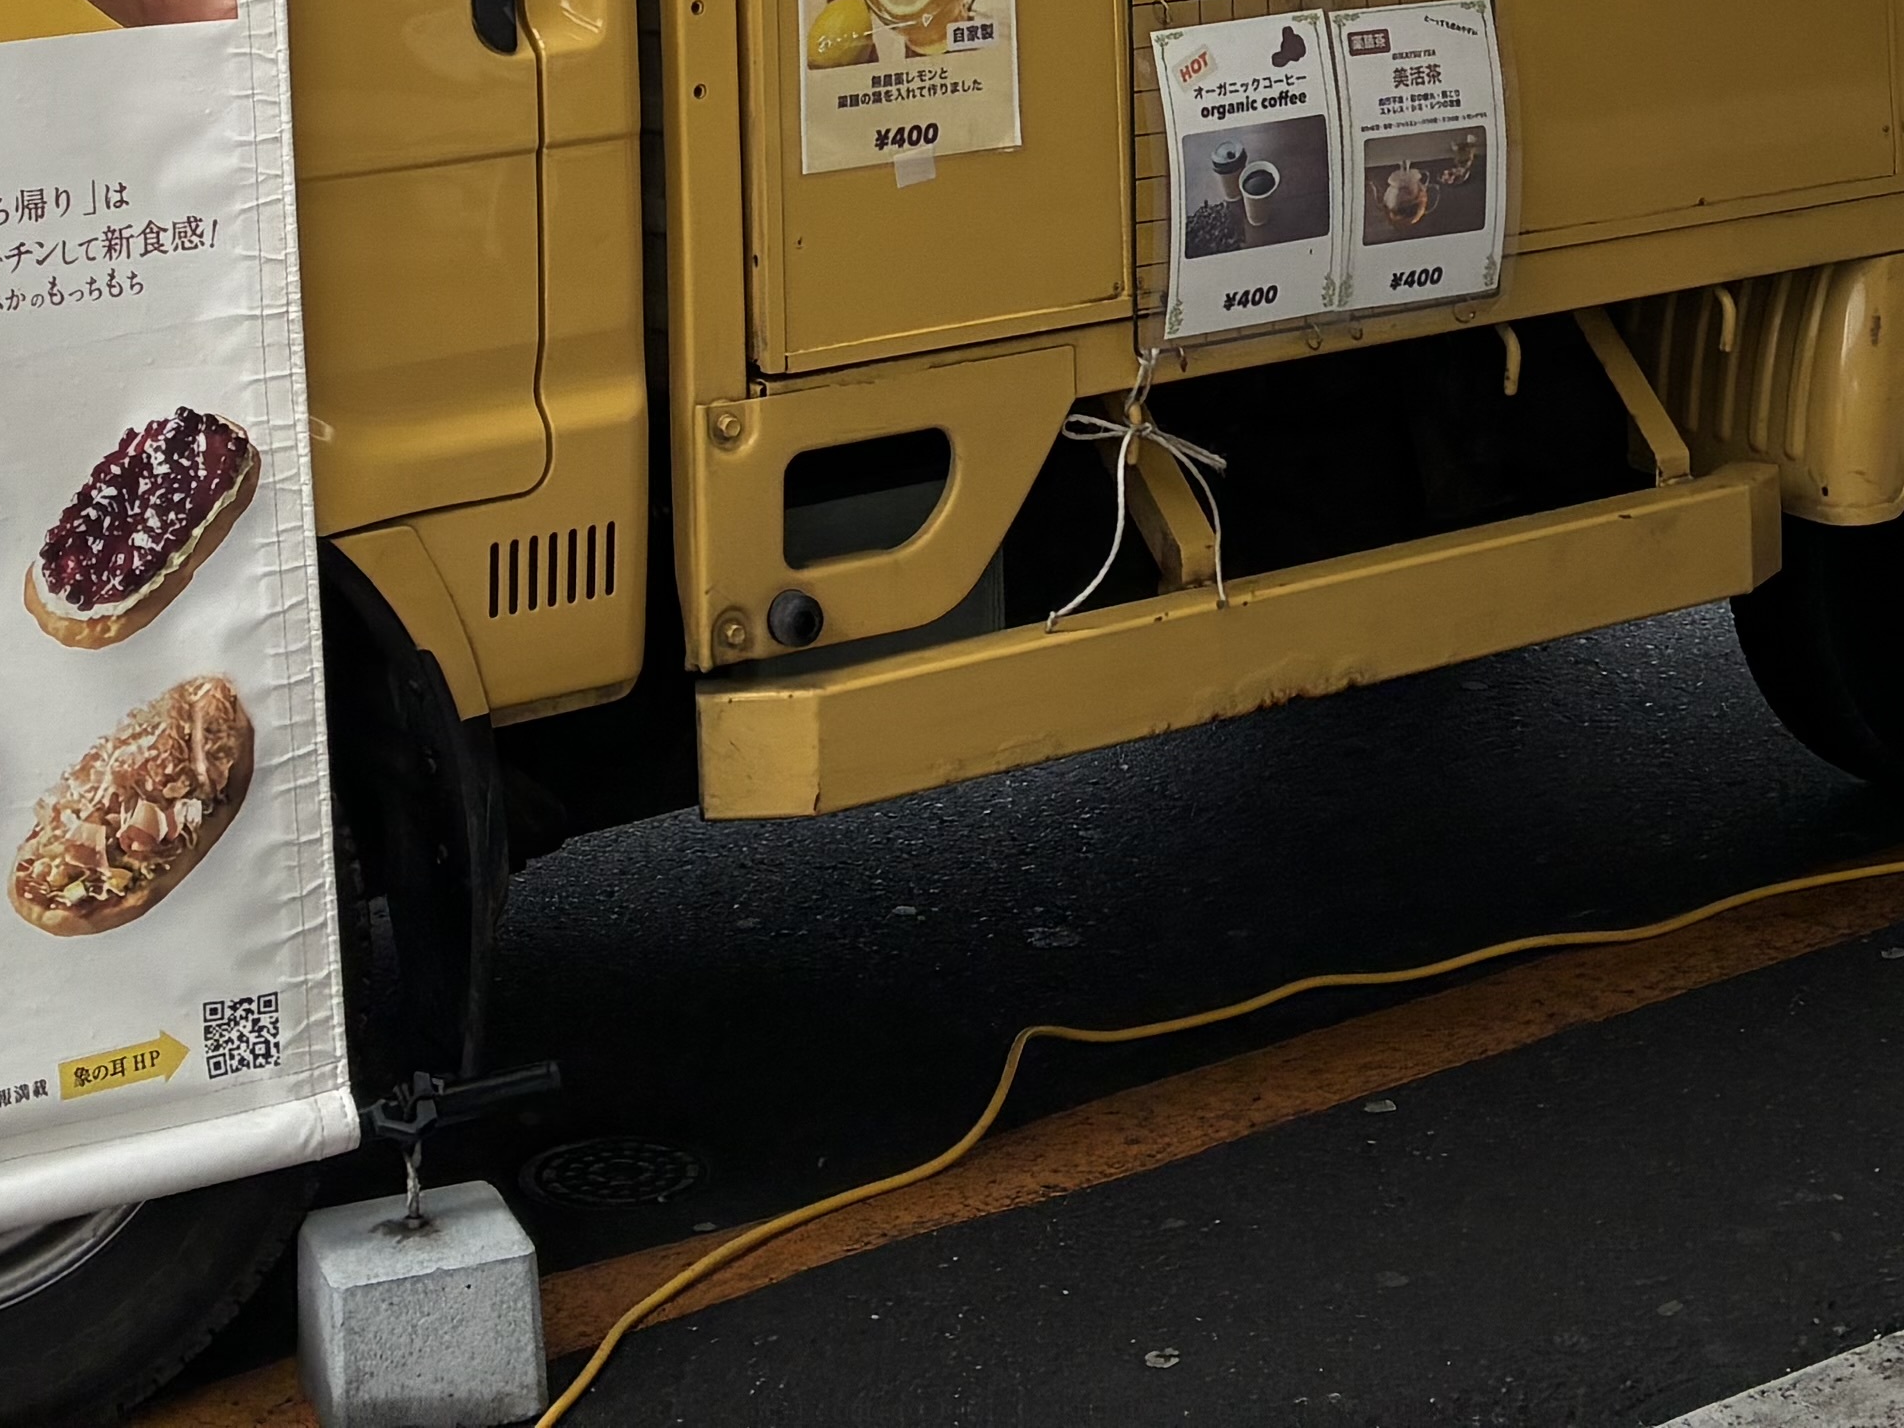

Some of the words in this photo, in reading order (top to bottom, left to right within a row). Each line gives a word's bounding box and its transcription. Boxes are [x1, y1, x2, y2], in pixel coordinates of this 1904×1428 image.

[1180, 50, 1210, 82] HOT
[1393, 63, 1443, 89] 美活茶
[1194, 73, 1307, 100] オーガニックコーヒー
[1200, 95, 1258, 120] organic
[1260, 90, 1308, 109] coffee
[875, 123, 939, 150] ¥400
[1390, 267, 1443, 291] ¥400
[1223, 285, 1278, 311] ¥400
[73, 1056, 127, 1089] 象の耳
[134, 1049, 161, 1073] HP
